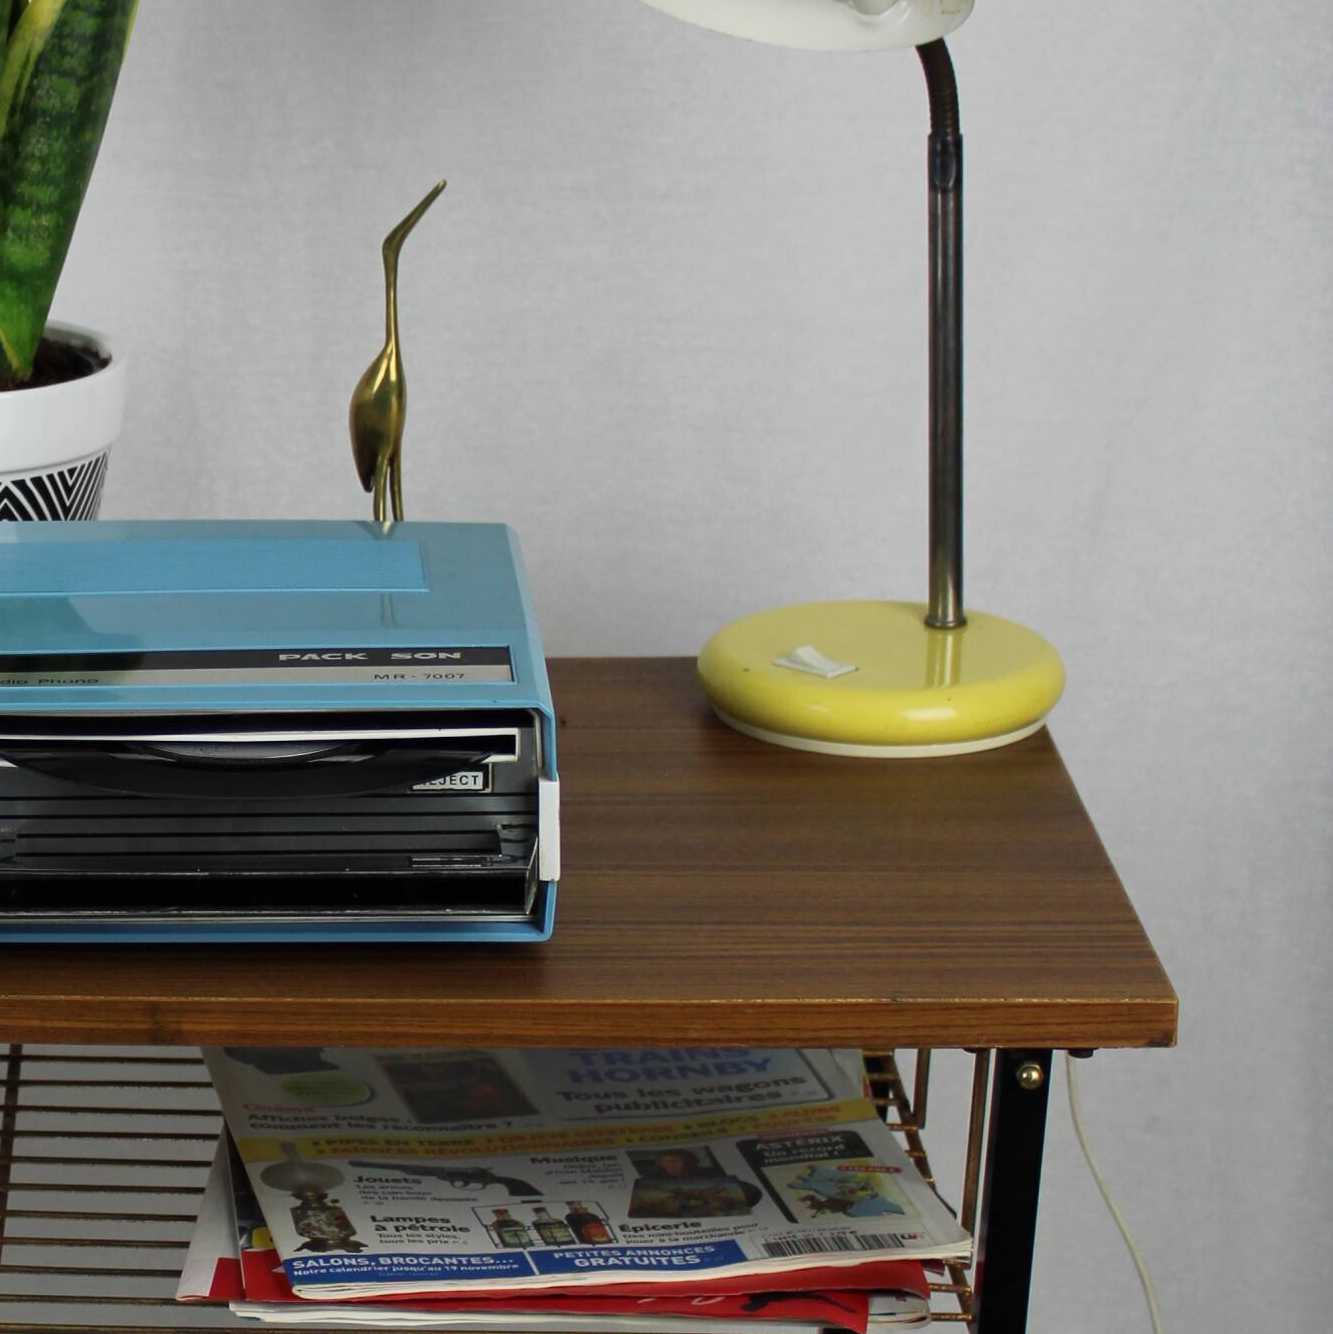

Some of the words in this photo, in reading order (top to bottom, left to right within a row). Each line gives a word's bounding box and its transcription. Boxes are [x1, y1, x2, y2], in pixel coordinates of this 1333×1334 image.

[278, 652, 368, 662] PACK
[390, 652, 462, 661] SON
[37, 677, 100, 685] Phono
[421, 775, 479, 786] EJECT
[570, 1049, 751, 1066] TRAINS
[568, 1059, 770, 1084] HORNBY
[556, 1091, 627, 1102] Tous
[637, 1088, 682, 1098] les
[691, 1076, 807, 1095] wagons
[593, 1090, 785, 1114] publicitaires
[250, 1121, 341, 1130] comment
[347, 1122, 376, 1130] les
[530, 1155, 618, 1165] Musique
[354, 1175, 423, 1185] Jouets
[370, 1215, 451, 1224] Lampes
[375, 1223, 387, 1231] à
[393, 1223, 471, 1233] pétrole
[618, 1221, 701, 1233] Épicerie
[552, 1249, 621, 1259] PETITES
[626, 1246, 716, 1257] ANNONCES
[292, 1257, 376, 1269] SALONS,
[378, 1256, 514, 1266] BROCANTES...
[573, 1255, 701, 1267] GRATUITES
[294, 1268, 327, 1276] Notre
